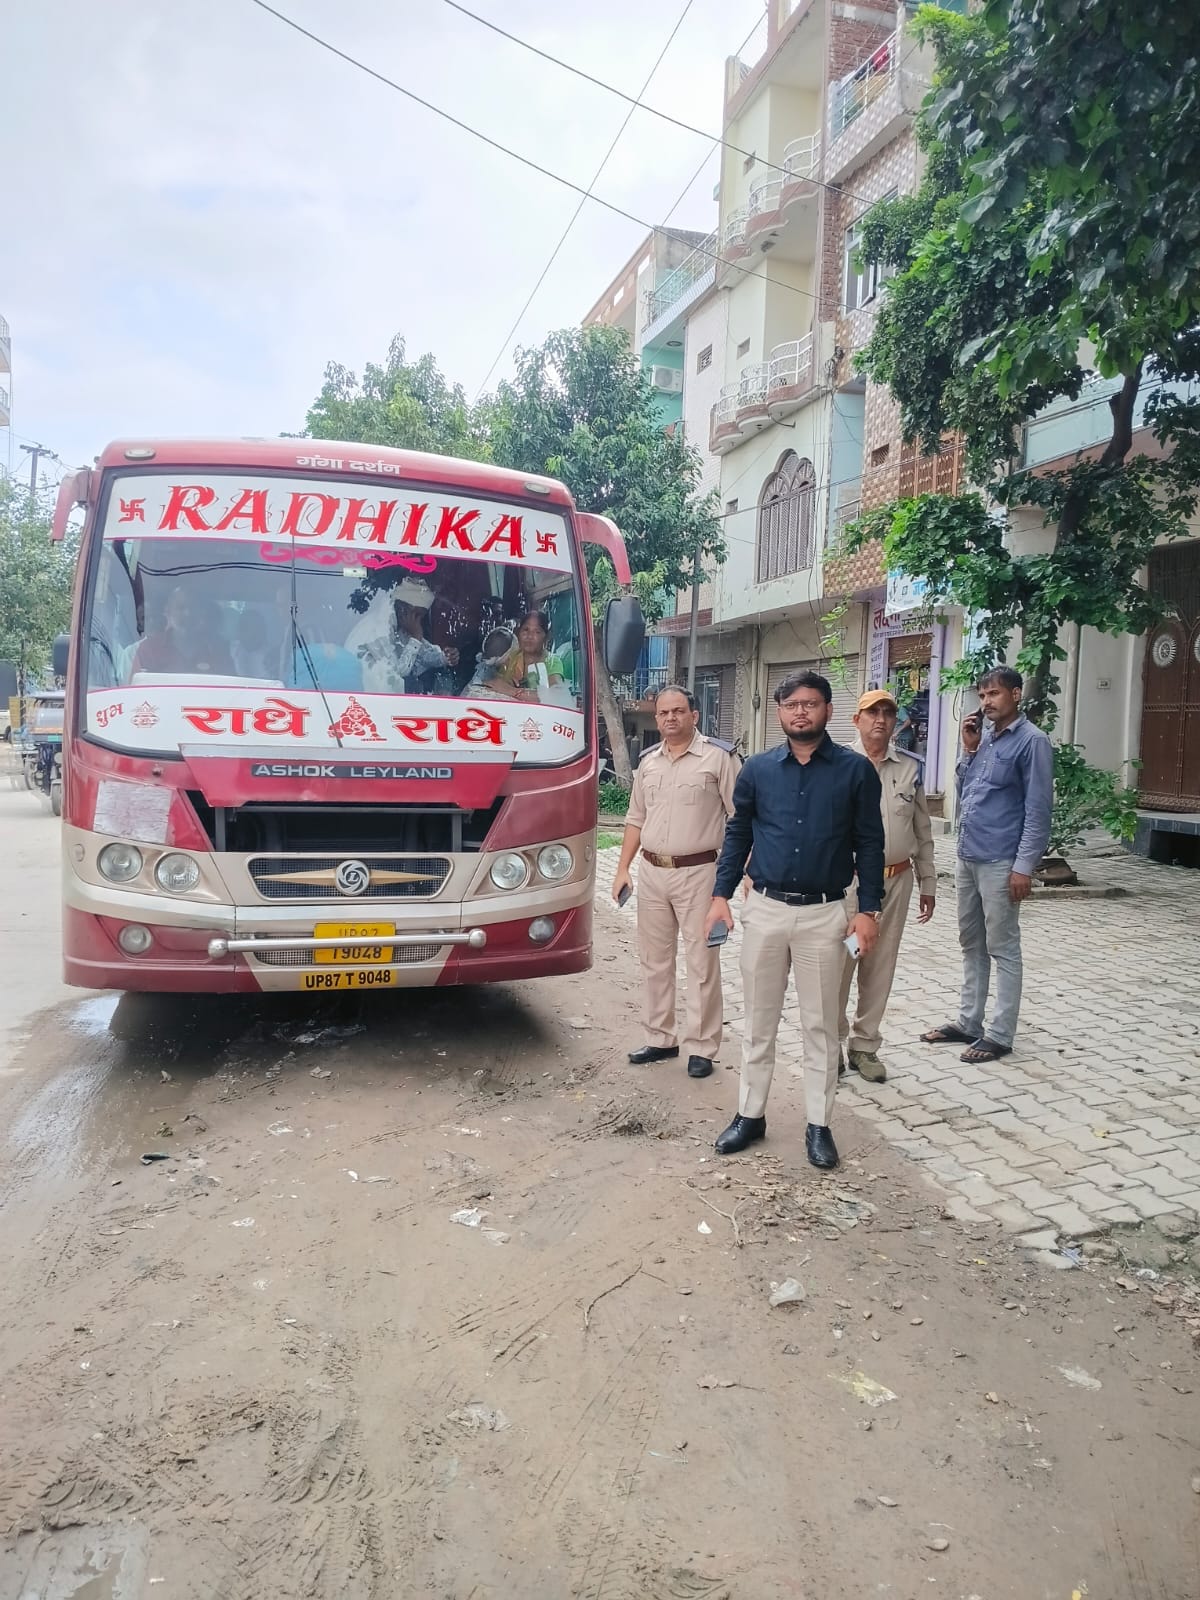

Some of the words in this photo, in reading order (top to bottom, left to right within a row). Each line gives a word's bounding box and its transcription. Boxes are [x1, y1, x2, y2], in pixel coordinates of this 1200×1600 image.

[296, 455, 344, 469] गंगा
[349, 460, 401, 475] दर्शन
[157, 484, 527, 558] RADHIKA
[96, 702, 124, 728] शुभ
[181, 697, 312, 738] राधे
[391, 707, 508, 746] राधे
[552, 721, 577, 741] लाभ
[255, 764, 336, 777] ASHOK
[350, 766, 452, 779] LEYLAND
[305, 973, 342, 988] UP87
[345, 972, 355, 985] T
[358, 969, 392, 984] 9048
